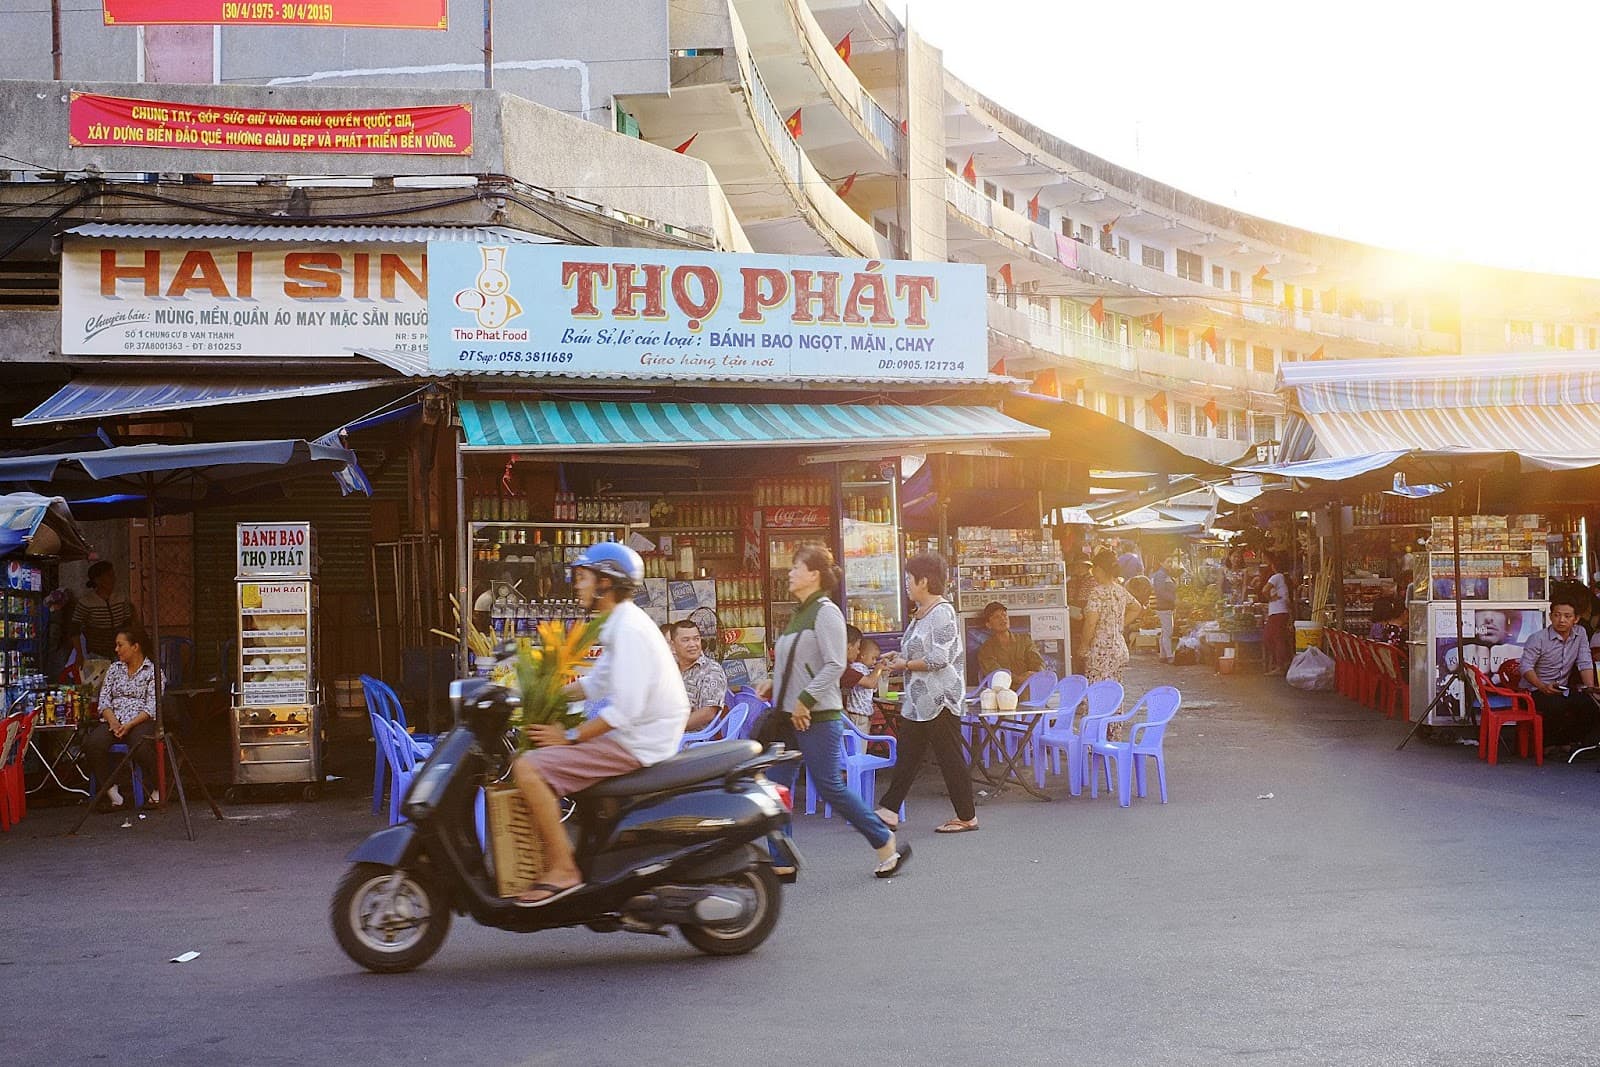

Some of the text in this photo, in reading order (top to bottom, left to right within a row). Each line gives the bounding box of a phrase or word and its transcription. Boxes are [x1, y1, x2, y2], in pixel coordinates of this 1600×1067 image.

[222, 2, 274, 20] (30/4/1975
[282, 3, 333, 21] 30/4/2015)
[132, 105, 168, 122] CHUNG
[172, 109, 196, 125] TAY,
[198, 110, 219, 123] GÓP
[223, 110, 244, 124] SỨC
[247, 111, 266, 124] GIỮ
[269, 112, 297, 126] VỮNG
[364, 111, 392, 128] QUỐC
[395, 113, 415, 128] GIA,
[88, 124, 109, 140] XÂY
[113, 126, 143, 142] DỰNG
[146, 122, 173, 143] BIỂN
[175, 125, 198, 143] ĐẢO
[201, 129, 222, 145] QUÊ
[226, 130, 262, 146] HƯƠNG
[265, 131, 290, 146] GIÀU
[293, 134, 315, 149] ĐẸP
[317, 131, 332, 147] VÀ
[335, 131, 362, 148] PHÁT
[366, 129, 398, 148] TRIỂN
[425, 132, 457, 148] VỮNG.
[101, 249, 428, 299] HAI SIN
[561, 259, 937, 331] THỌ PHÁT
[85, 310, 127, 334] Chuyên
[127, 308, 151, 322] bán:
[155, 306, 198, 326] MÙNG,
[233, 306, 269, 327] QUẦN
[274, 307, 291, 326] ÁO
[296, 311, 326, 326] MAY
[330, 309, 358, 328] MẶC
[362, 306, 389, 326] SẴN
[124, 328, 136, 338] SỐ
[139, 330, 143, 338] 1
[190, 331, 206, 340] VẠN
[208, 332, 234, 341] THẠNH
[454, 329, 528, 341] Tho Phat Food
[561, 328, 592, 344] Bán
[635, 330, 661, 346] các
[709, 328, 756, 348] BÁNH
[761, 334, 793, 348] BAO
[895, 337, 935, 352] CHAY
[207, 342, 242, 351] 810253
[459, 350, 476, 361] ĐT
[499, 351, 574, 363] 058.3811689
[640, 352, 775, 368] Giao hàng tận nơi
[242, 526, 304, 546] BÁNH BAO
[241, 546, 304, 568] THỌ PHÁT
